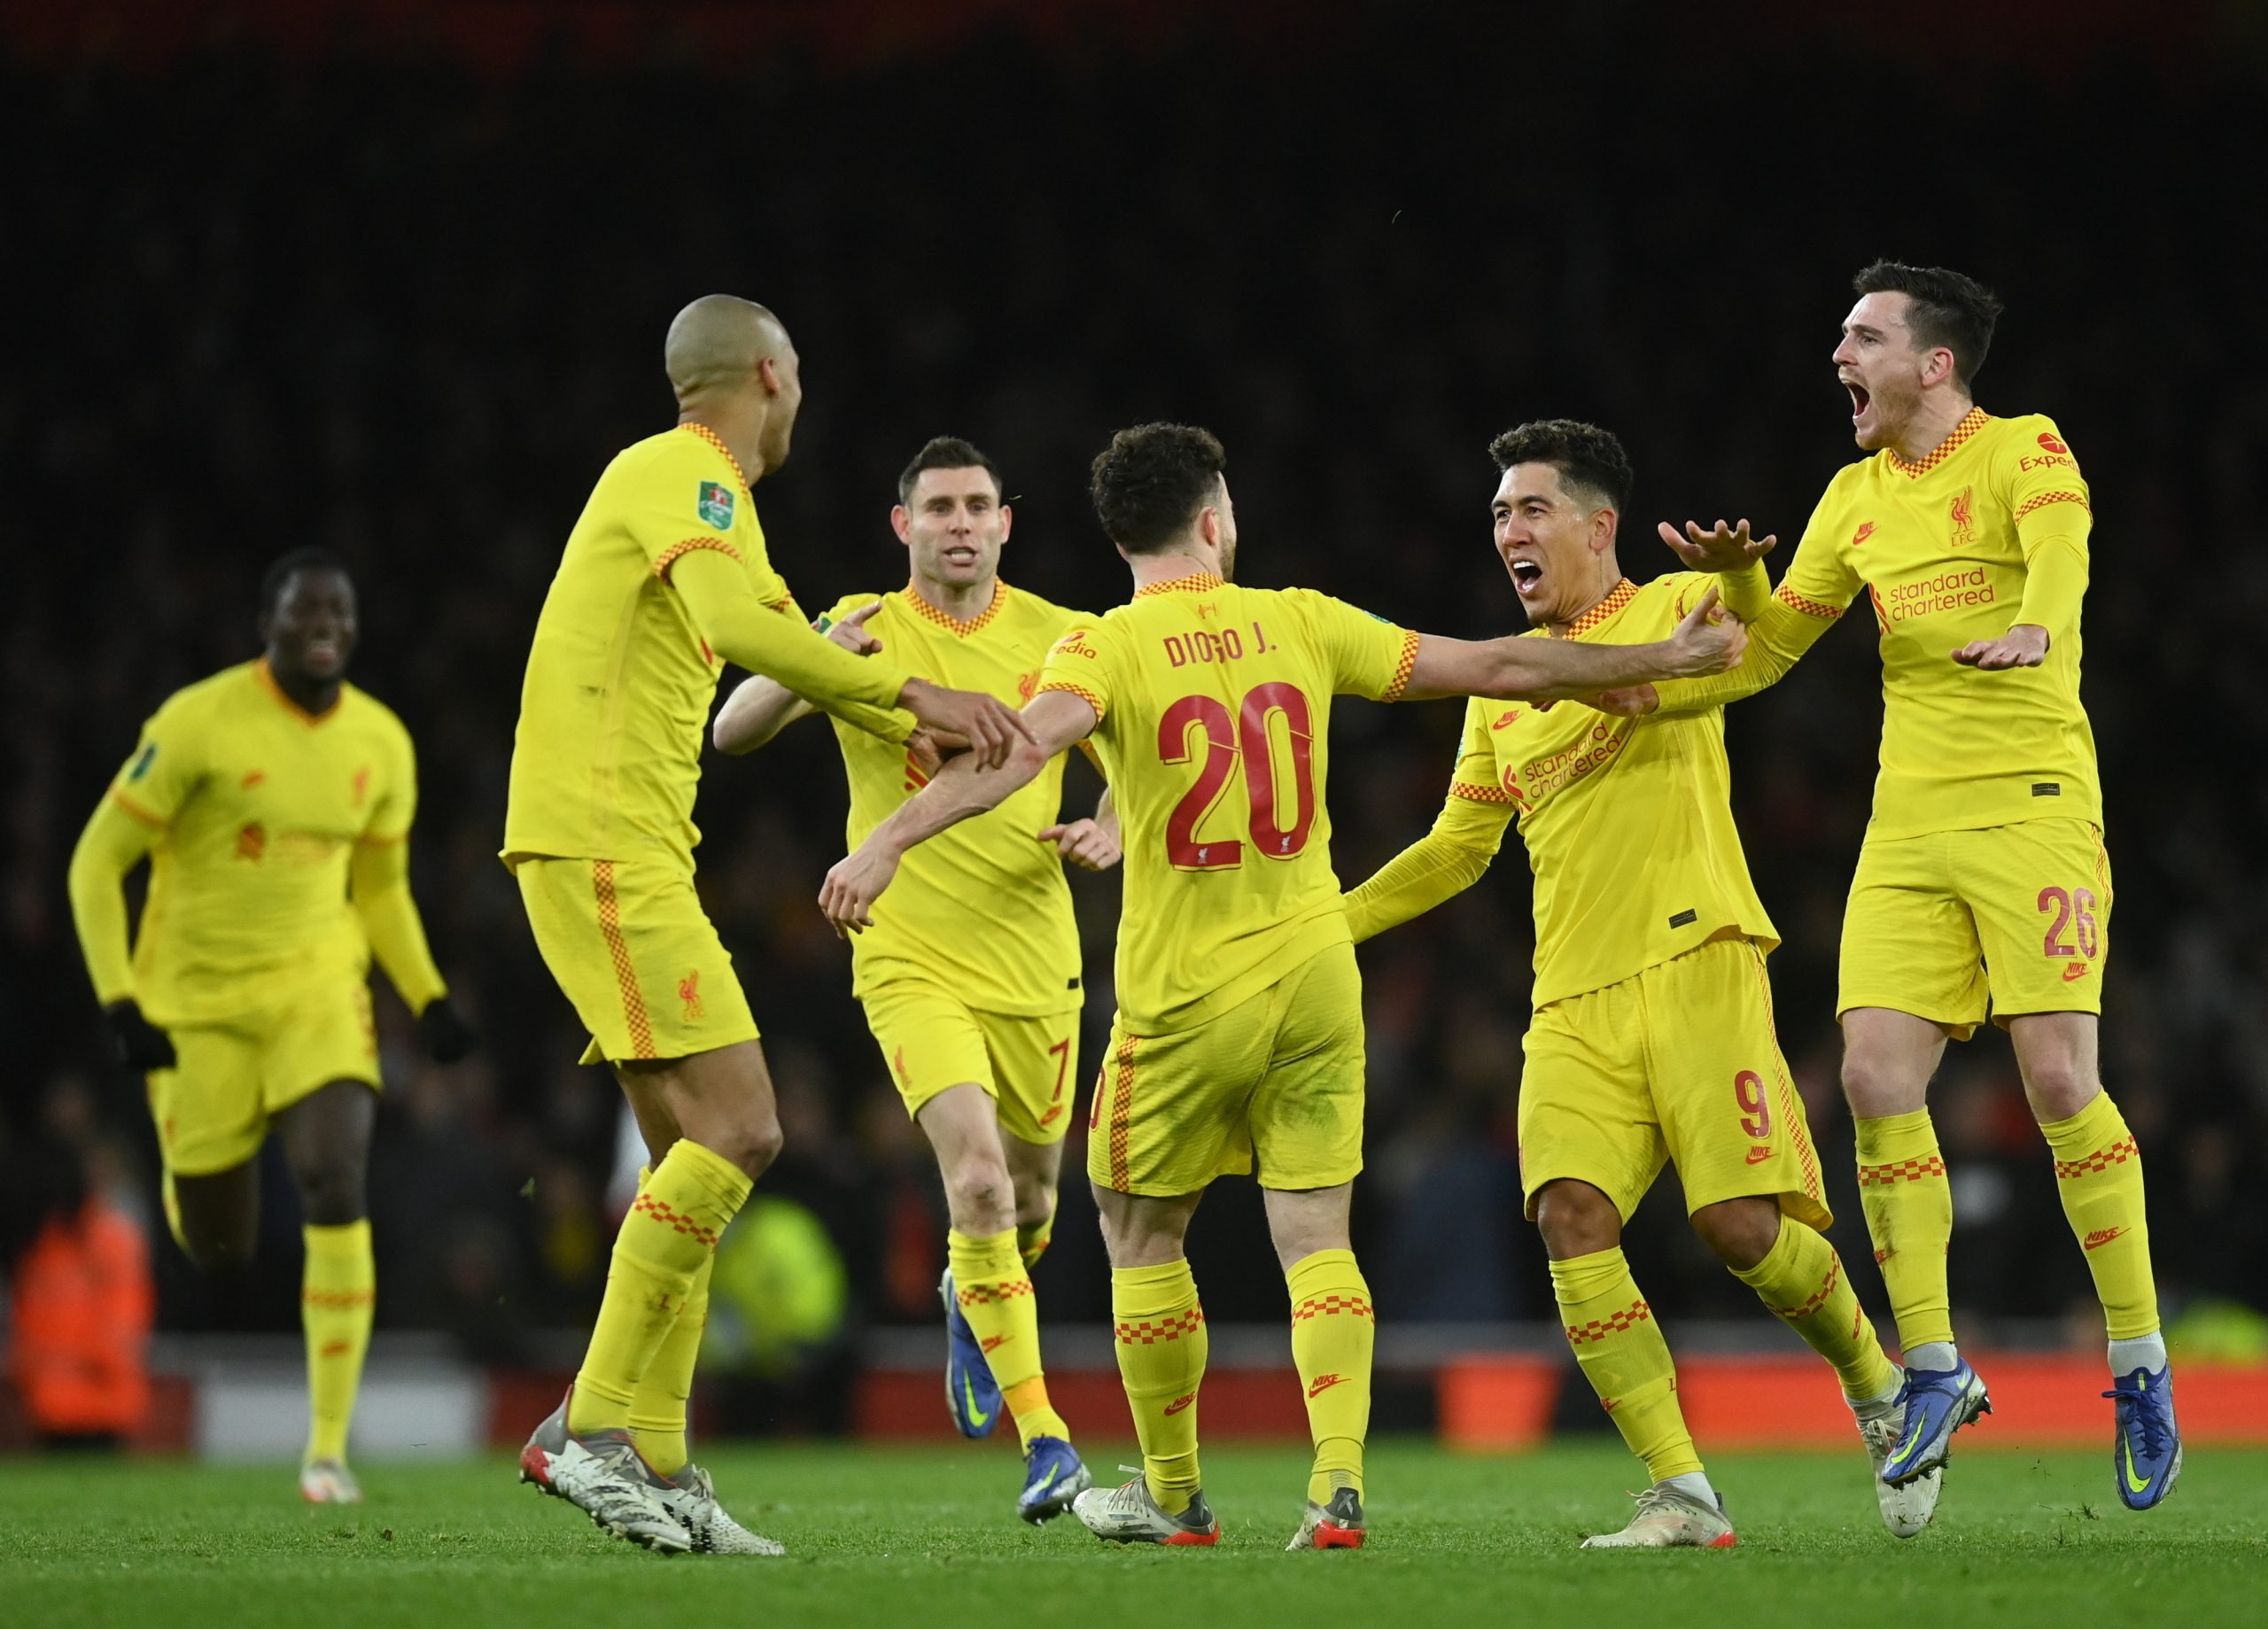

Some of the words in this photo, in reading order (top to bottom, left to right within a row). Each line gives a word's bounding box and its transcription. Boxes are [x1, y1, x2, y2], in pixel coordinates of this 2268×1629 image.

[2019, 455, 2079, 472] Exped
[1951, 531, 1977, 547] LFC
[1890, 567, 1984, 603] standard
[1892, 585, 1995, 622] chartered
[1252, 621, 1278, 655] J.
[1525, 721, 1609, 781] standard
[1530, 734, 1620, 799] chartered
[1158, 681, 1317, 872] 20
[2038, 886, 2098, 960] 26
[2066, 962, 2087, 974] NIKE
[1049, 1036, 1069, 1103] 7
[1734, 1069, 1771, 1139] 9
[1749, 1145, 1772, 1158] NIKE
[2086, 1226, 2119, 1242] NIKE
[1312, 1373, 1340, 1388] NIKE
